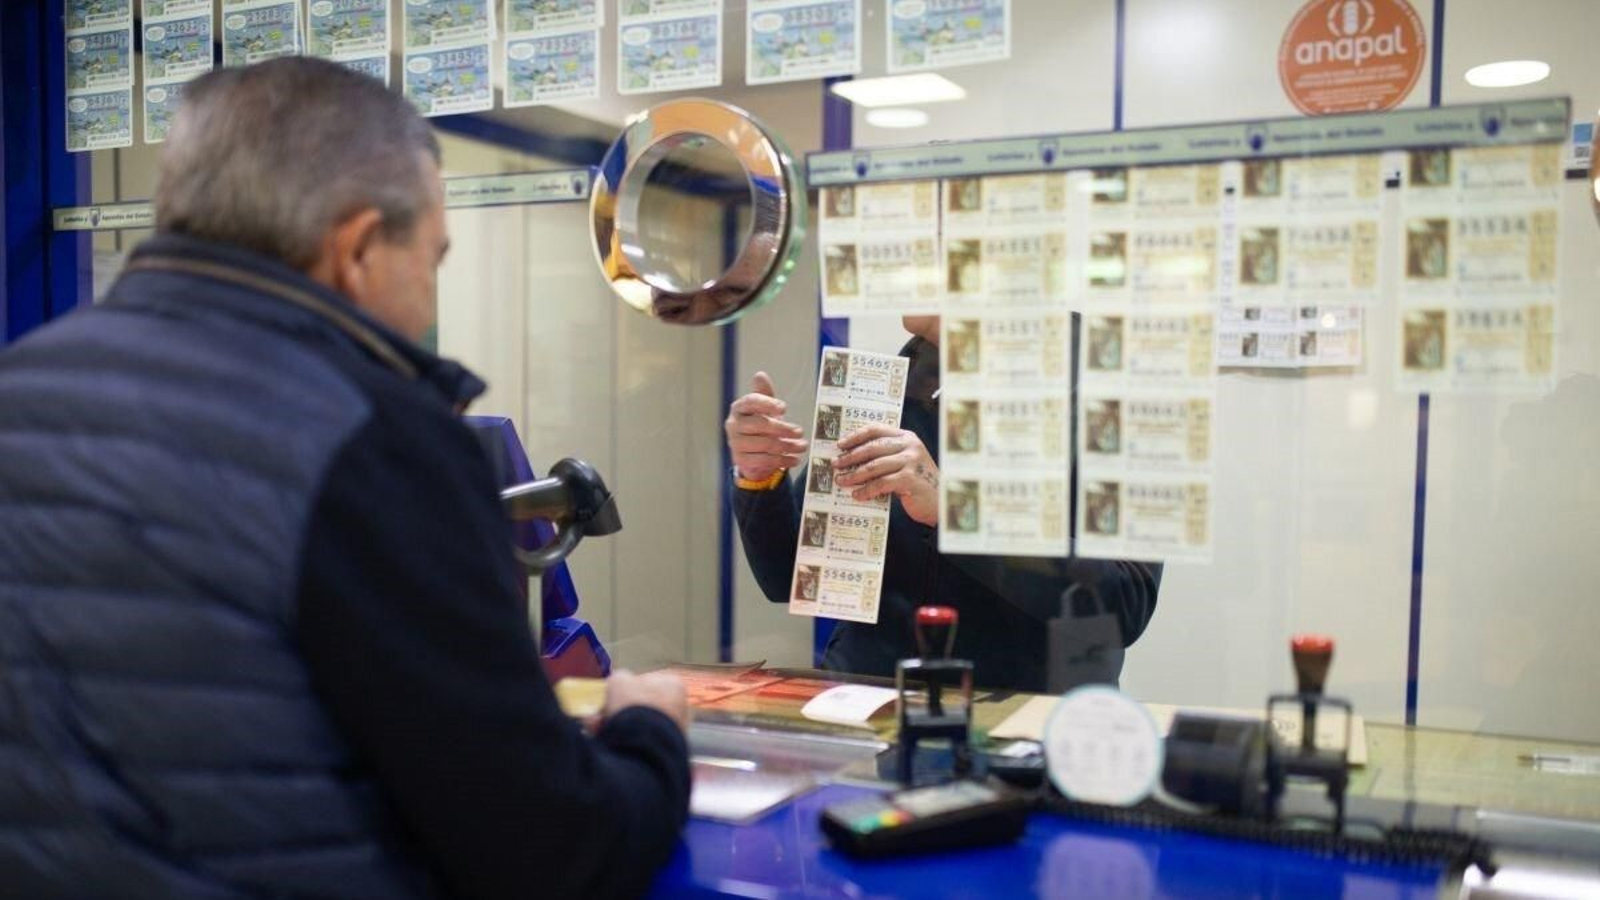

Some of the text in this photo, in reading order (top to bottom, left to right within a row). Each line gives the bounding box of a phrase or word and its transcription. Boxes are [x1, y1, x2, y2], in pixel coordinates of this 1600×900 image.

[1295, 25, 1408, 67] anapal
[852, 356, 890, 369] 55465
[845, 408, 883, 421] 55465
[831, 515, 870, 528] 55465
[823, 569, 863, 583] 55465
